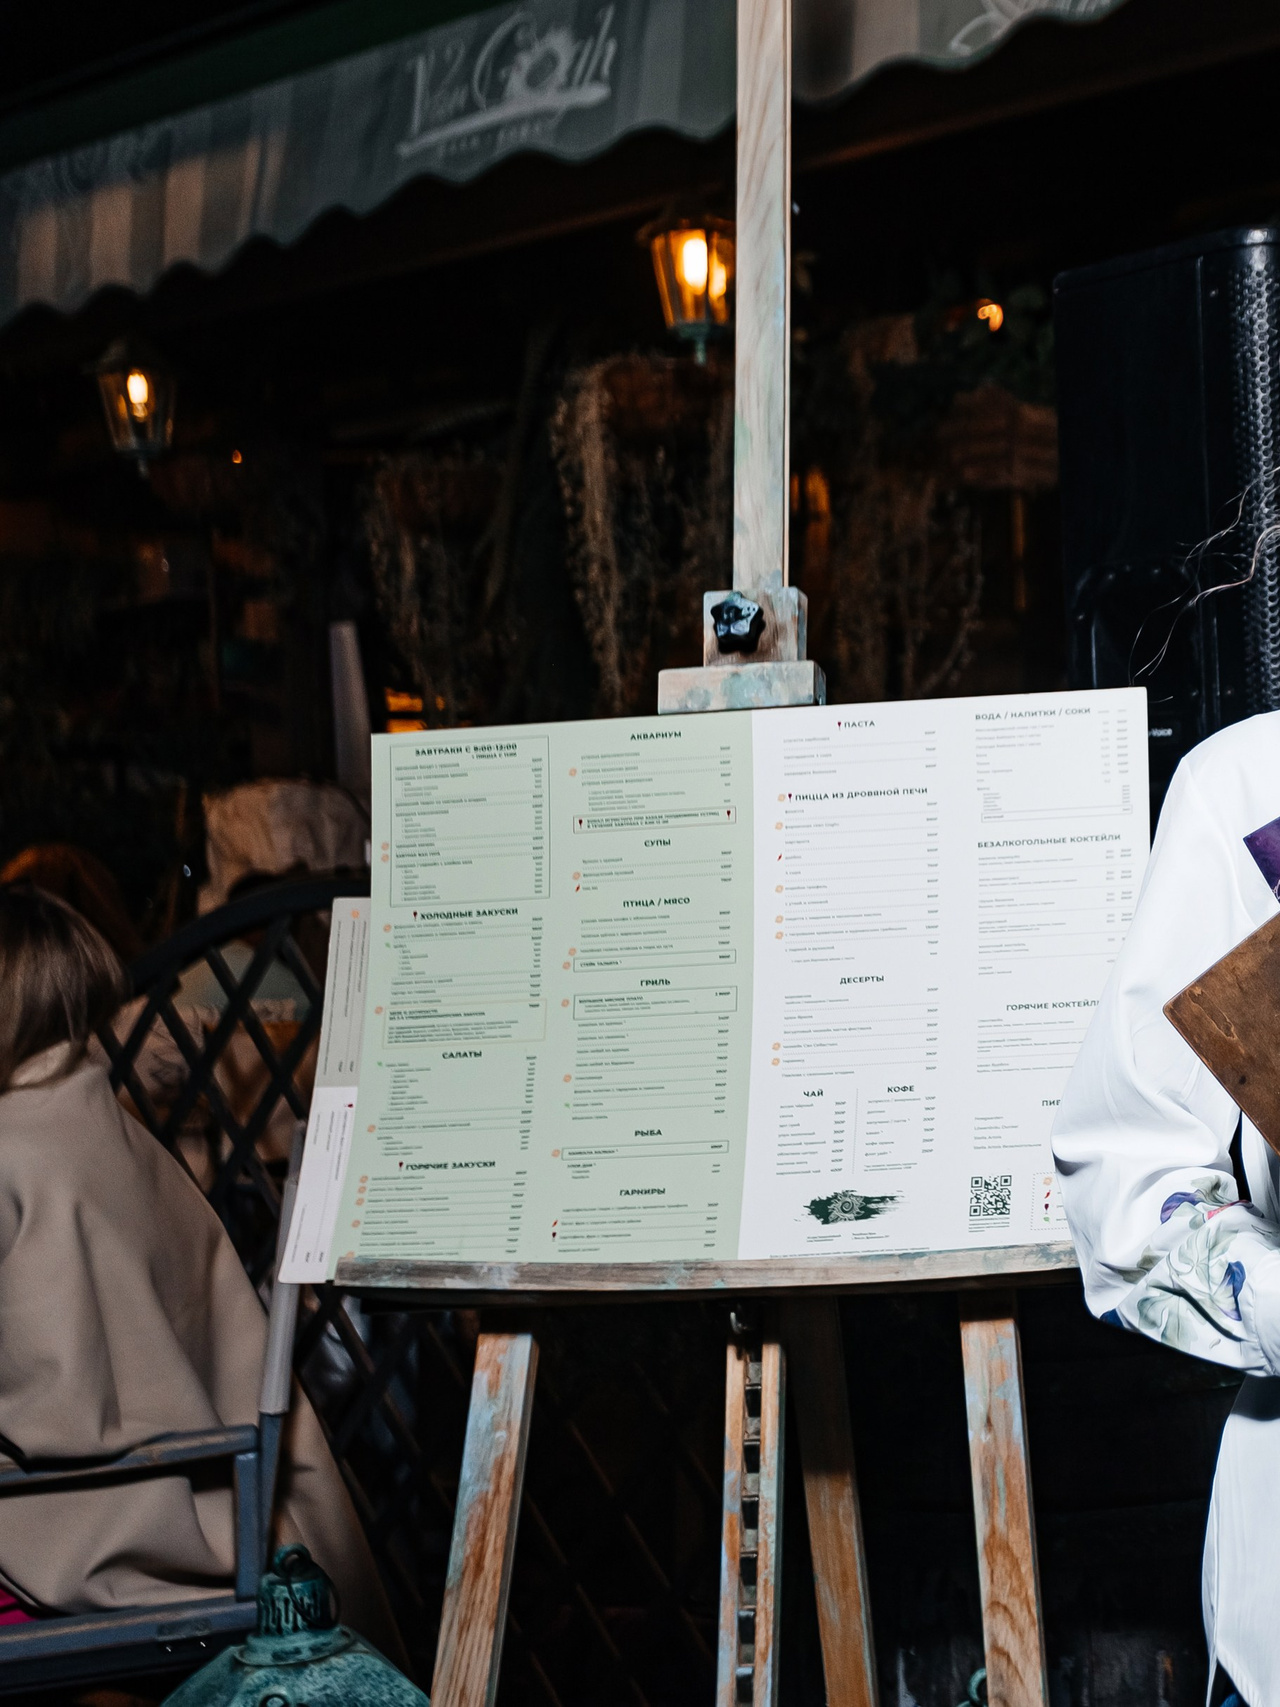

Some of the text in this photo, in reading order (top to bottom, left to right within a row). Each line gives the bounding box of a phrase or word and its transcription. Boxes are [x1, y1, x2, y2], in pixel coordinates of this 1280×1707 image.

[975, 711, 1002, 721] ВОДА
[1010, 708, 1056, 719] НАПИТКИ
[1065, 707, 1091, 716] СОКИ
[844, 719, 876, 729] ПАСТА
[630, 730, 682, 741] АКВАРИУМ
[795, 786, 928, 803] ПИЦЦА ИЗ ДРОВЯНОЙ ПЕЧИ
[644, 838, 672, 848] СУПЫ
[977, 833, 1121, 849] БЕЗАЛКОГОЛЬНЫЕ КОКТЕЙЛИ
[622, 898, 655, 909] ПТИЦА
[664, 896, 691, 906] МЯСО
[420, 907, 519, 922] ХОЛОДНЫЕ ЗАКУСКИ
[640, 978, 671, 987] ГРИЛЬ
[839, 974, 885, 986] ДЕСЕРТЫ
[1006, 1001, 1050, 1012] ГОРЯЧИЕ
[442, 1050, 483, 1060] САЛАТЫ
[803, 1088, 824, 1098] ЧАЙ
[887, 1084, 915, 1094] КОФЕ
[634, 1129, 663, 1138] РЫБА
[405, 1160, 496, 1171] ГОРЯЧИЕ ЗАКУСКИ
[619, 1187, 666, 1197] ГАРНИРЫ
